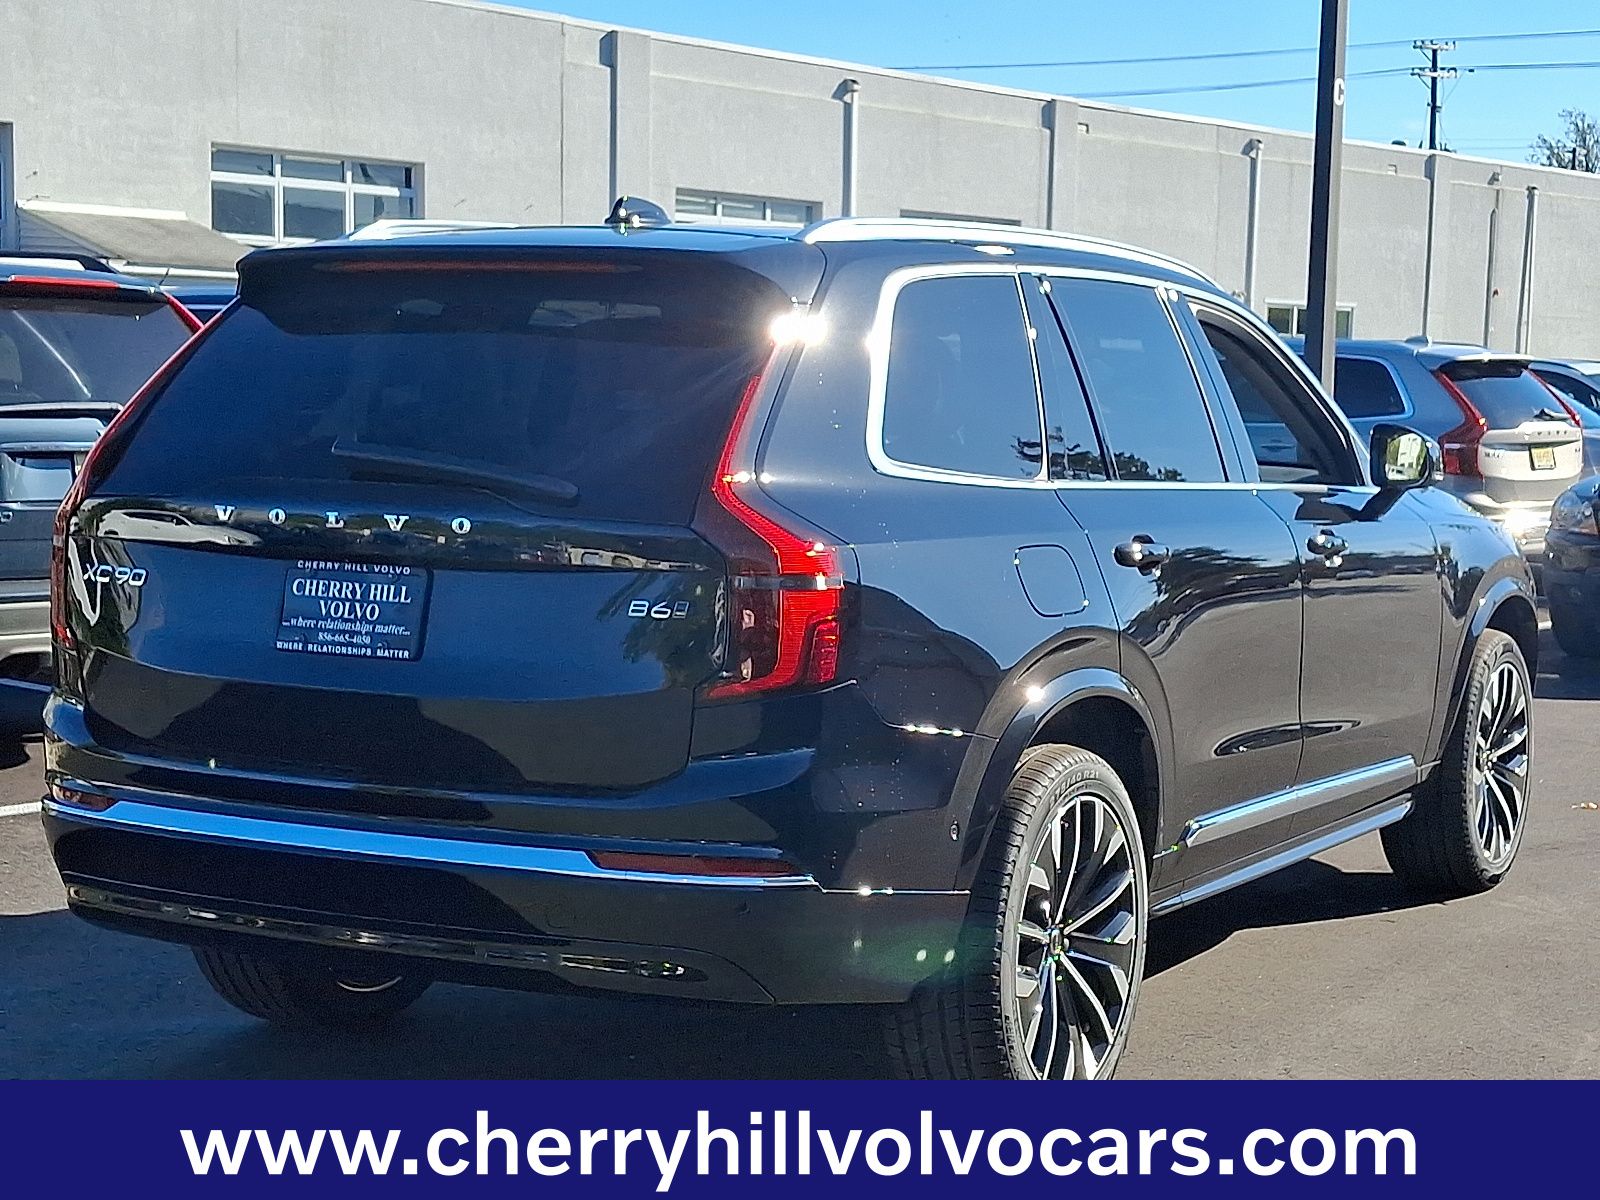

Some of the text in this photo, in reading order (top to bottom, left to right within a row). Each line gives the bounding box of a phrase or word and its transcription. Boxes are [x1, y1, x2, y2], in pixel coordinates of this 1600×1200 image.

[214, 504, 472, 535] VOLVO
[83, 563, 147, 586] XC90
[297, 560, 411, 575] CHERRY HILL VOLVO
[292, 578, 412, 603] CHERRY HILL
[319, 600, 380, 621] VOLVO
[628, 600, 672, 619] B6
[317, 619, 373, 635] relationships
[276, 641, 410, 659] WHERE RELATIONSHIPS MATTER
